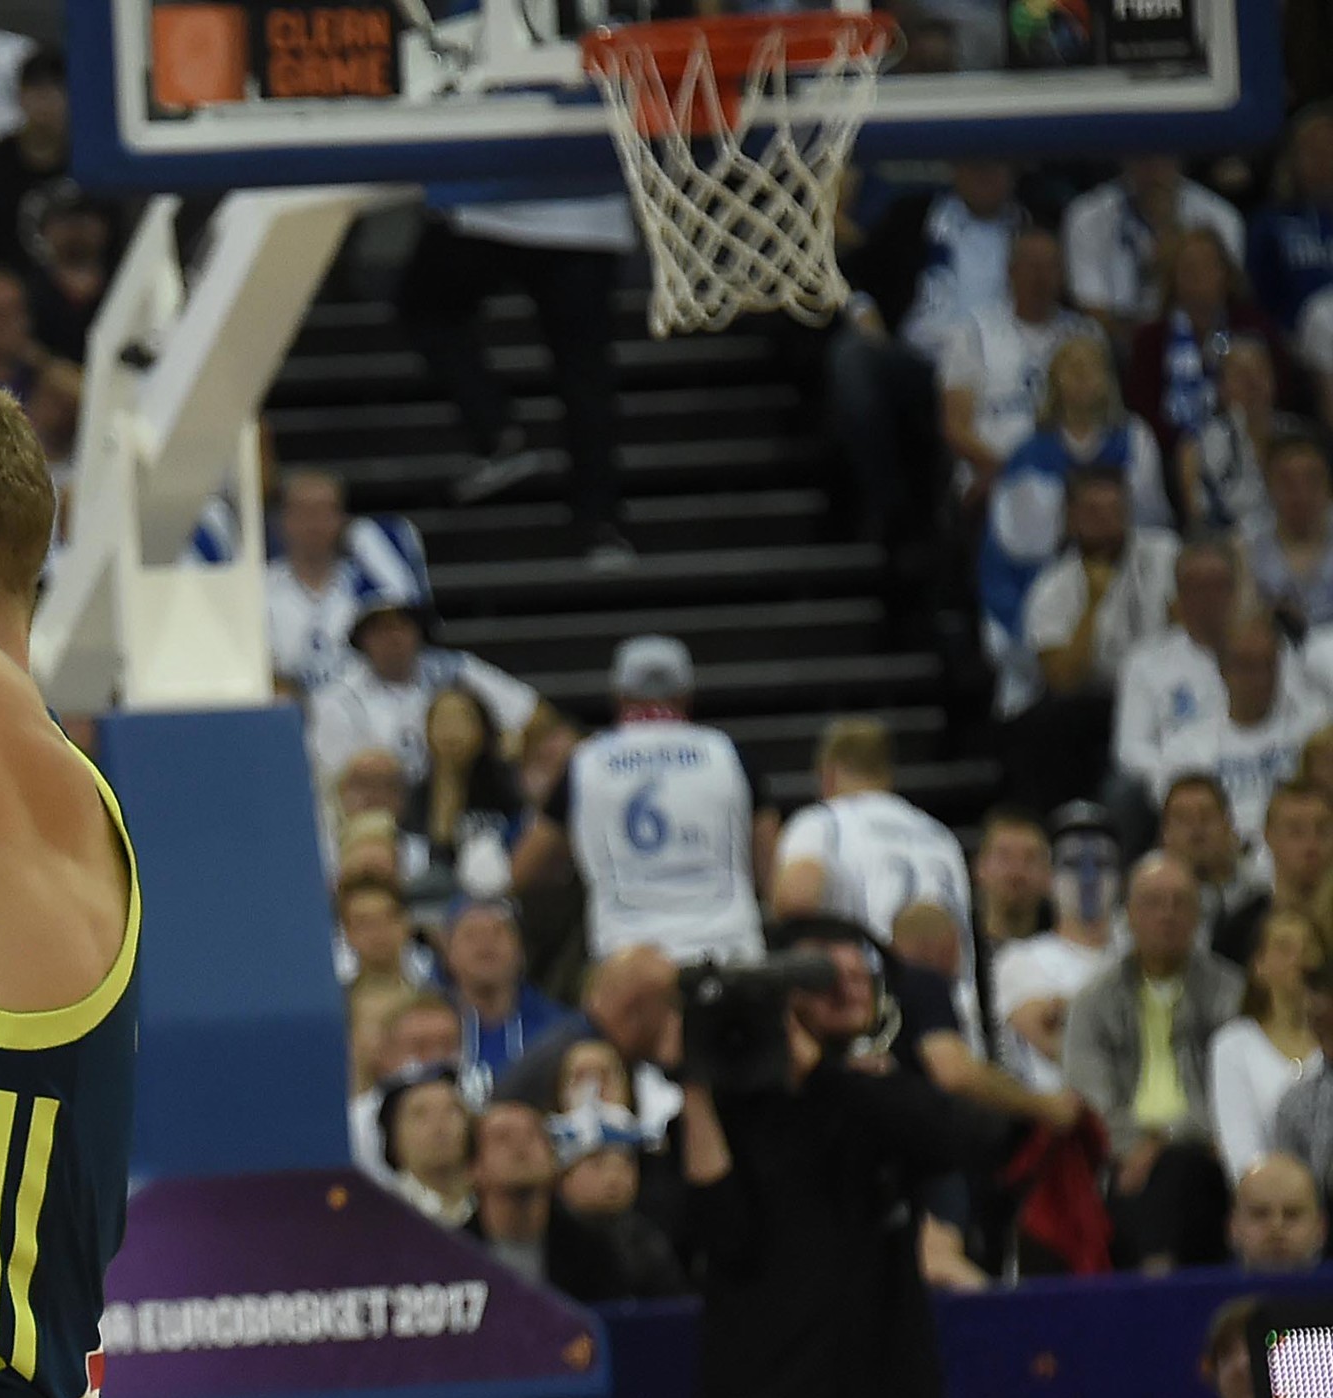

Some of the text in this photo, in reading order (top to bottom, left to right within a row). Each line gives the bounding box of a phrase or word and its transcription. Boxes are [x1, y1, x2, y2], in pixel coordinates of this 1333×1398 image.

[266, 9, 392, 47] CLEAN
[267, 49, 393, 95] GAME
[625, 780, 668, 854] 6
[136, 1286, 389, 1353] EUROBASKET
[392, 1279, 489, 1338] 2017
